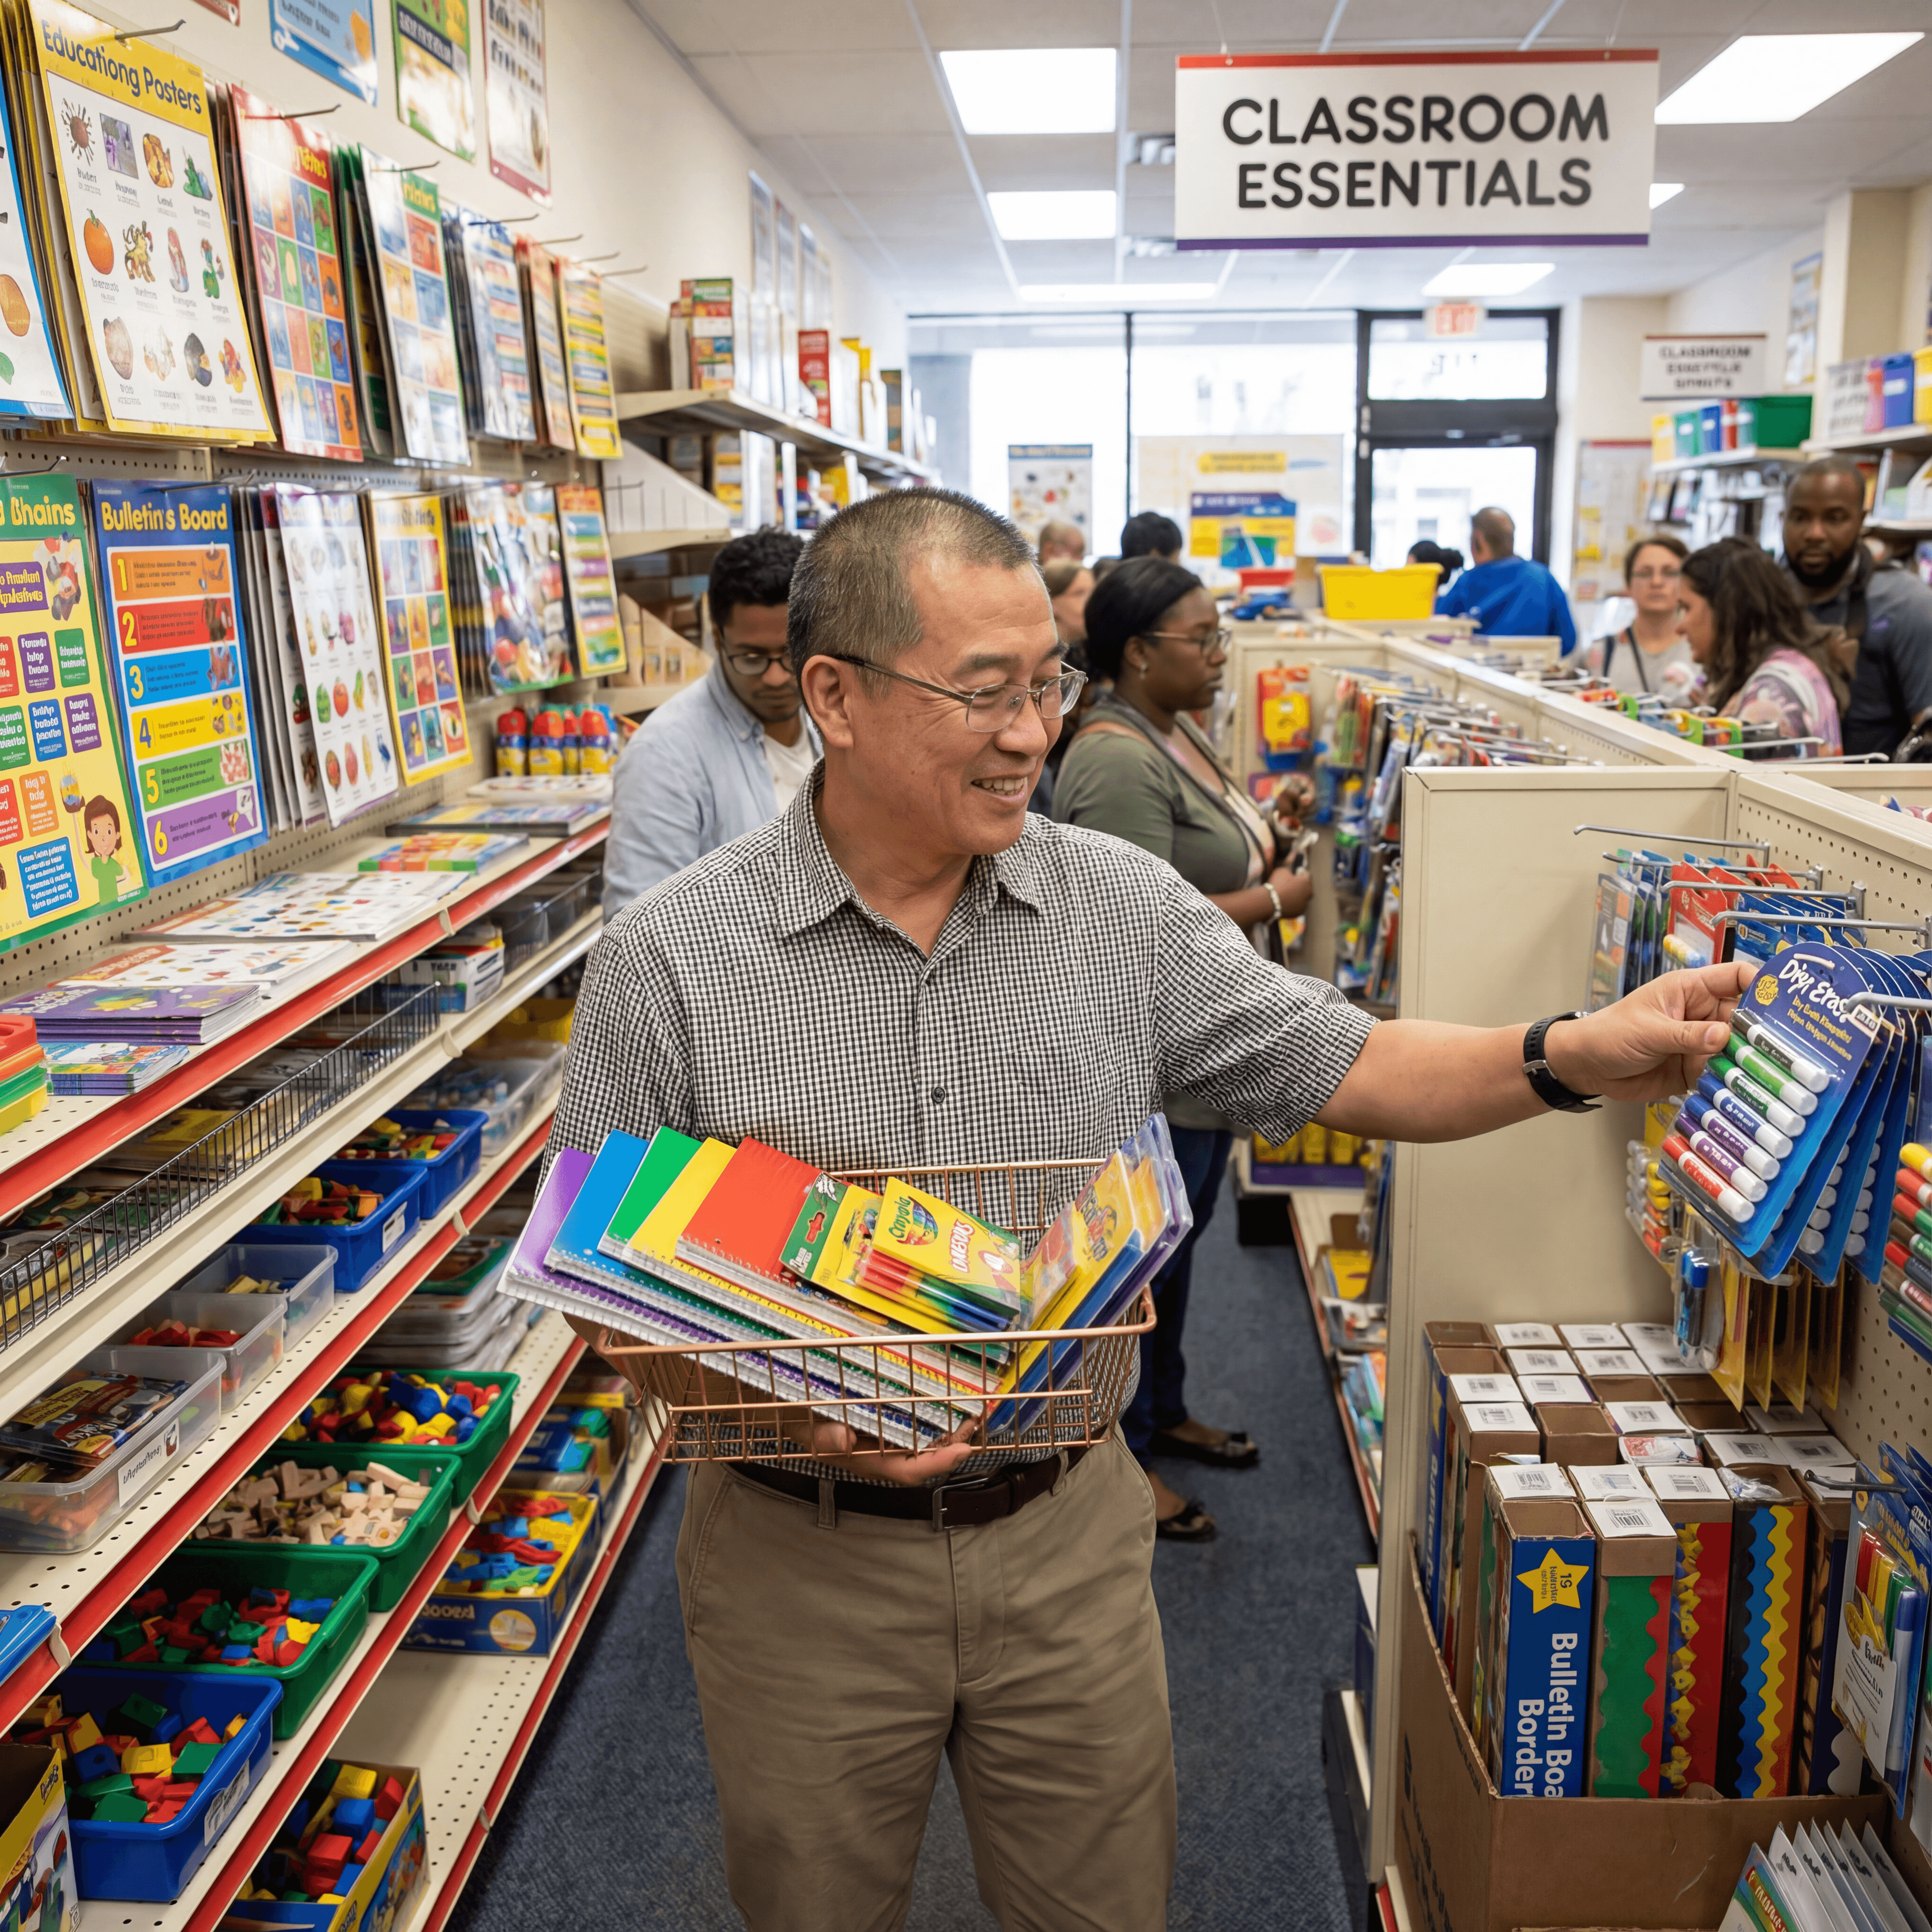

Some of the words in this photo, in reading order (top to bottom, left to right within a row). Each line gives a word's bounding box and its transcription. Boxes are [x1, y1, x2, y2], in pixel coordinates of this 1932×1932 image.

[42, 19, 140, 97] Educationg
[143, 66, 201, 114] Posters
[1223, 94, 1609, 145] CLASSROOM
[1238, 158, 1591, 208] ESSENTIALS
[101, 501, 176, 530] Bulletin's
[179, 503, 228, 530] Board
[117, 558, 128, 591] 1
[122, 611, 137, 647] 2
[129, 665, 143, 699] 3
[139, 717, 151, 748] 4
[146, 768, 159, 803] 5
[154, 820, 168, 855] 6
[1547, 1633, 1578, 1740] Bulletin
[1514, 1699, 1545, 1797] Border
